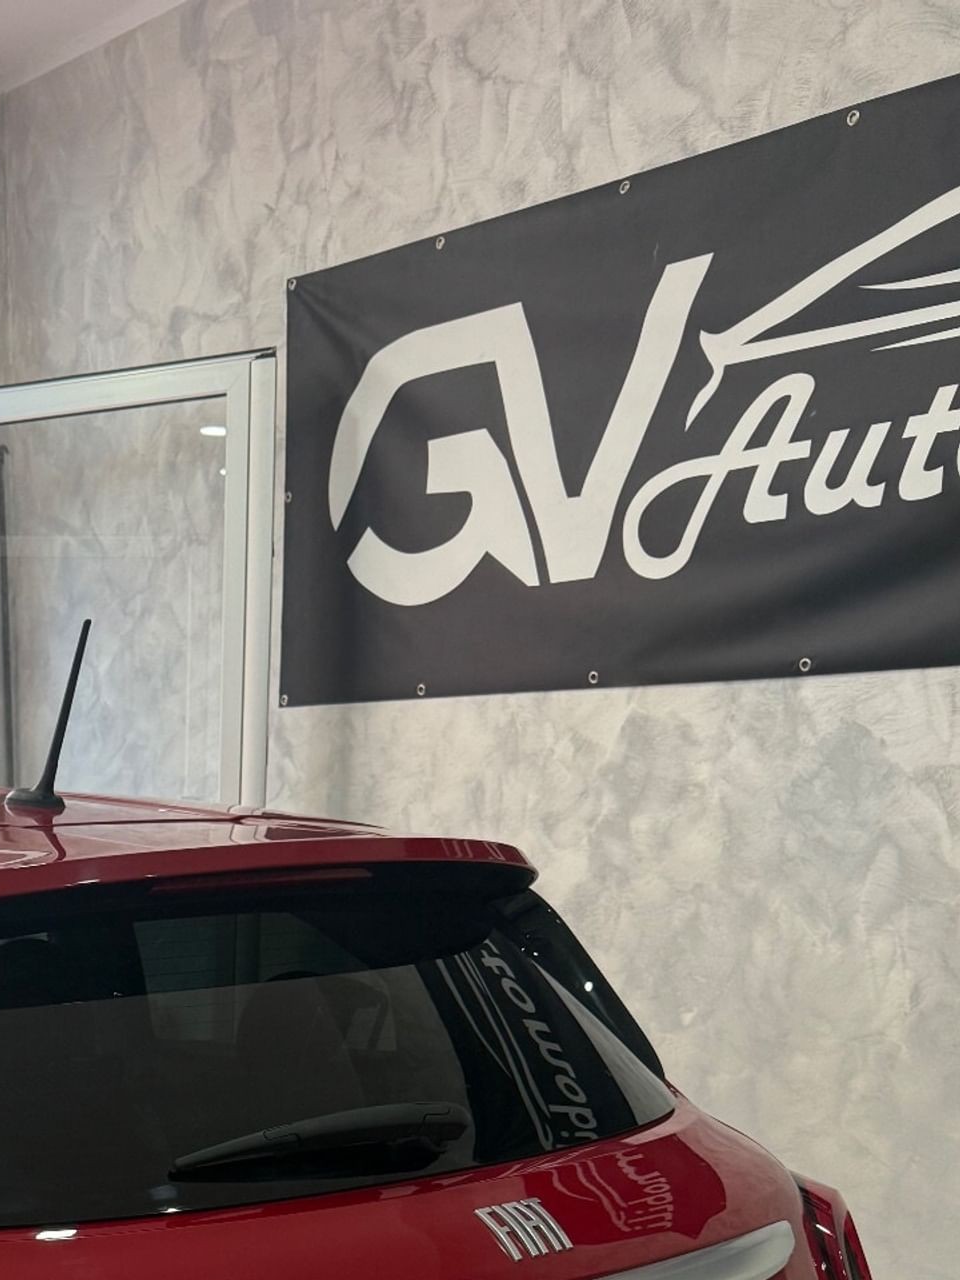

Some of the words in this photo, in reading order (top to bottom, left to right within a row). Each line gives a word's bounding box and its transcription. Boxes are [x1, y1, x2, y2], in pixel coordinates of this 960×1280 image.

[328, 252, 715, 606] GV
[623, 372, 960, 579] Aut
[473, 1197, 574, 1262] FIAT
